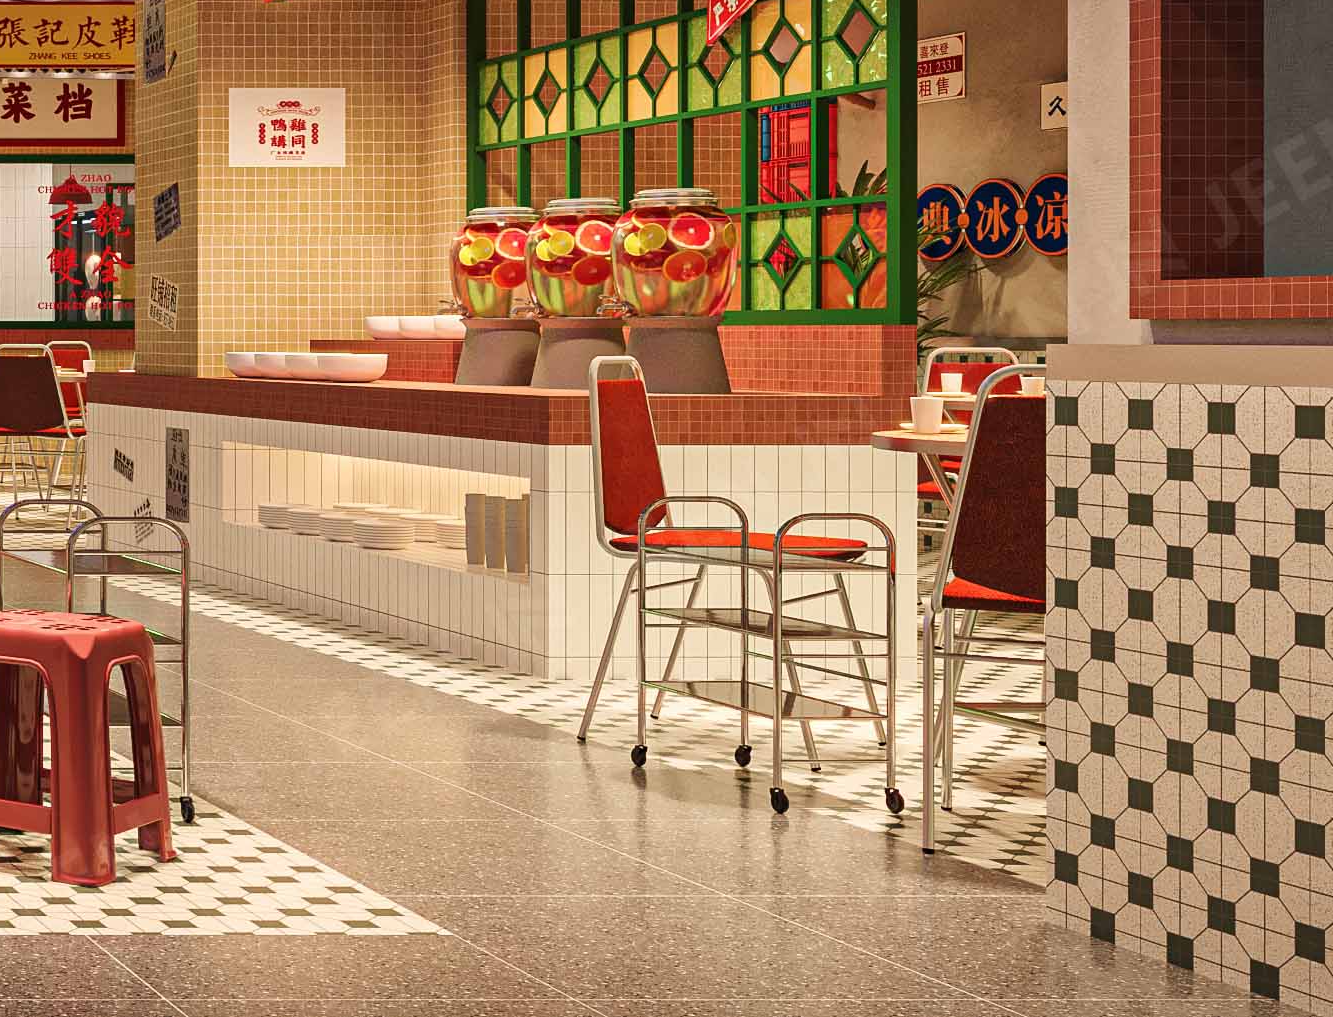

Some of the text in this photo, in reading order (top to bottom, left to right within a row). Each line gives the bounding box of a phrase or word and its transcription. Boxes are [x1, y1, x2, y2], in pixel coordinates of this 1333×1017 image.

[29, 52, 112, 60] ZHANG KEE SHOES
[935, 60, 957, 73] 2331
[81, 174, 112, 182] ZHAO
